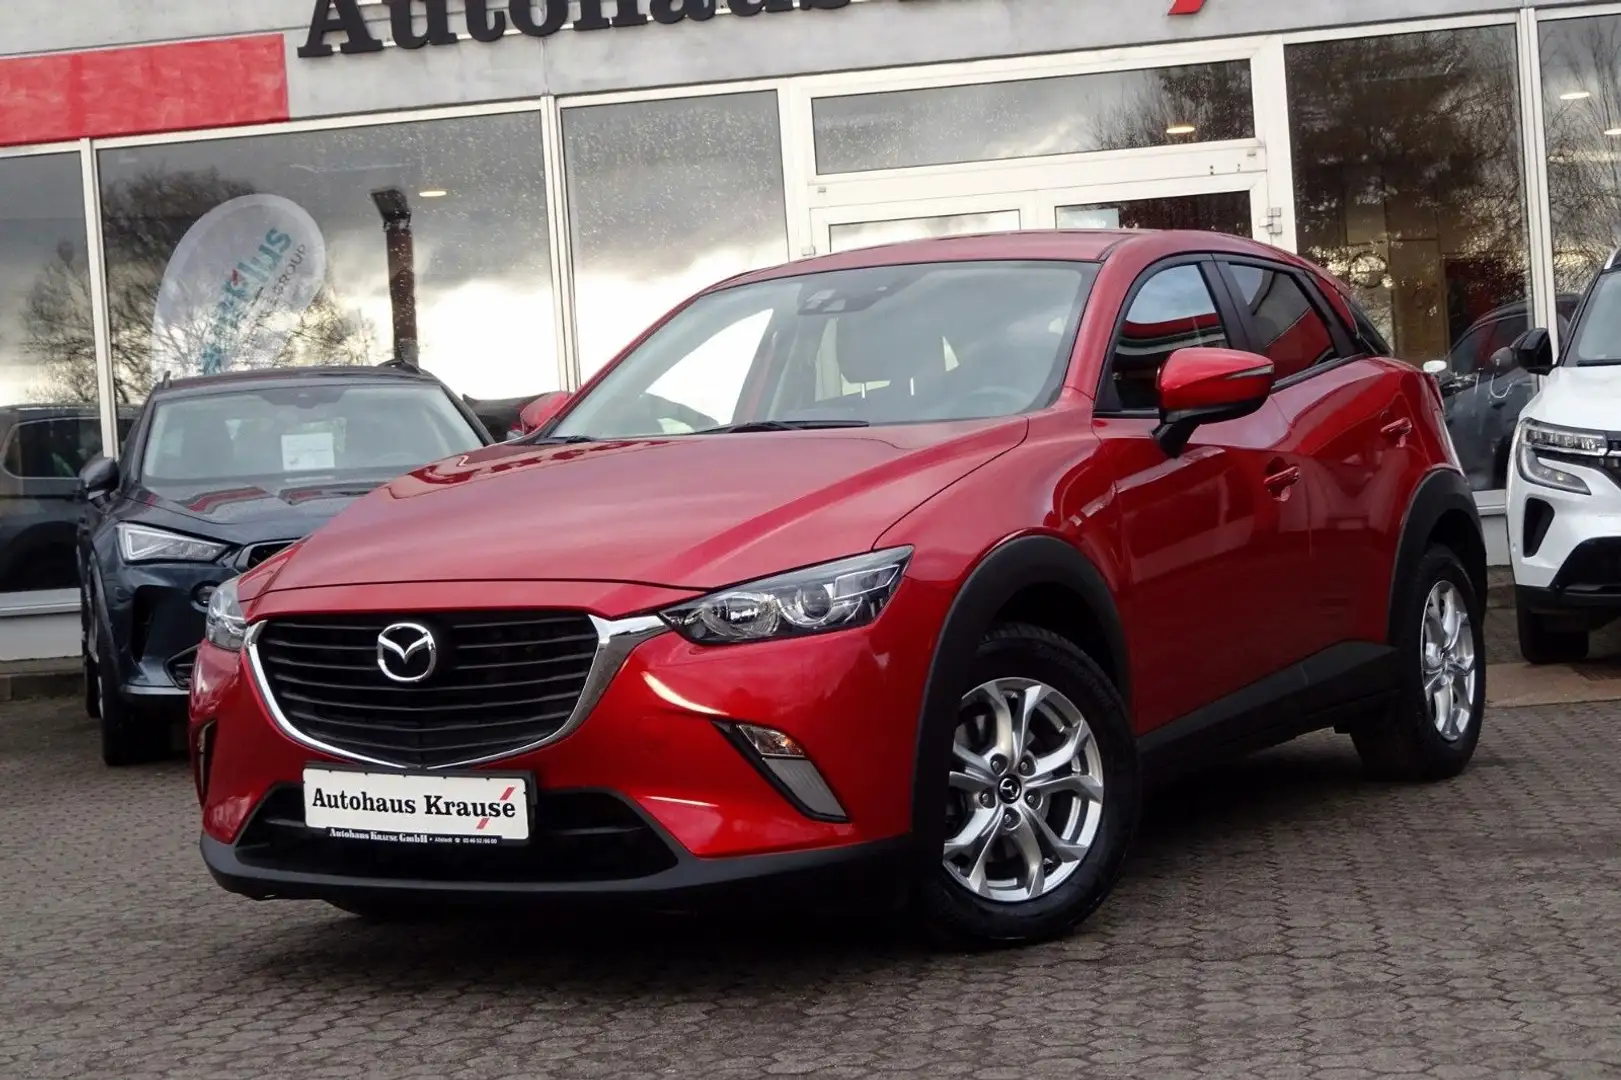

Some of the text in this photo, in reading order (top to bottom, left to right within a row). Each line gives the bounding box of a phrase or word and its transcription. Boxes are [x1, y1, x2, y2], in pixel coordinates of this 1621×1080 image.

[312, 787, 516, 818] Autohaus Krause
[329, 828, 369, 840] Autohaus
[399, 833, 428, 844] GmbH
